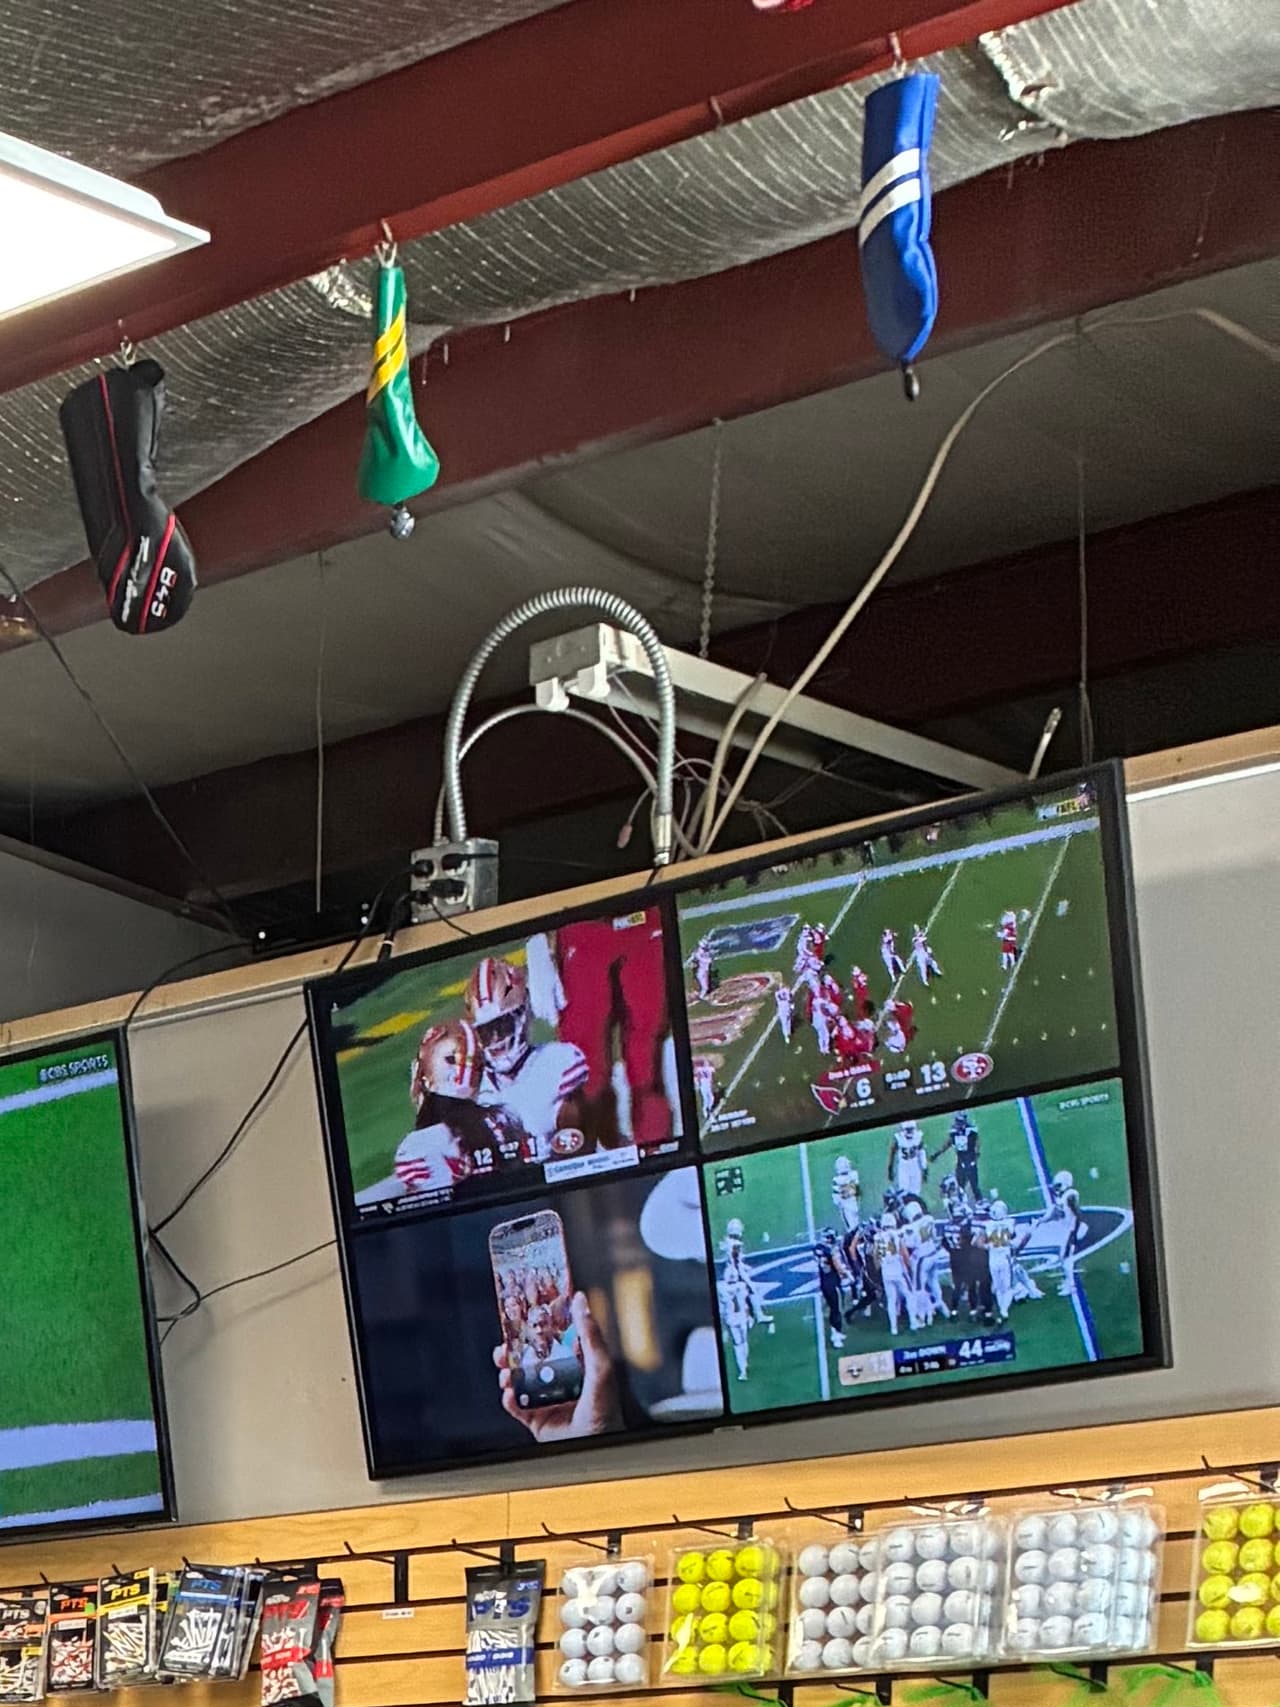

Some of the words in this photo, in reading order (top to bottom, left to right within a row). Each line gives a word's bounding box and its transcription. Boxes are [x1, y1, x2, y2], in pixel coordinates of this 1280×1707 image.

[920, 1061, 946, 1085] 13
[958, 1339, 983, 1359] 44
[111, 1583, 141, 1600] PTS
[2, 1608, 31, 1621] PTS
